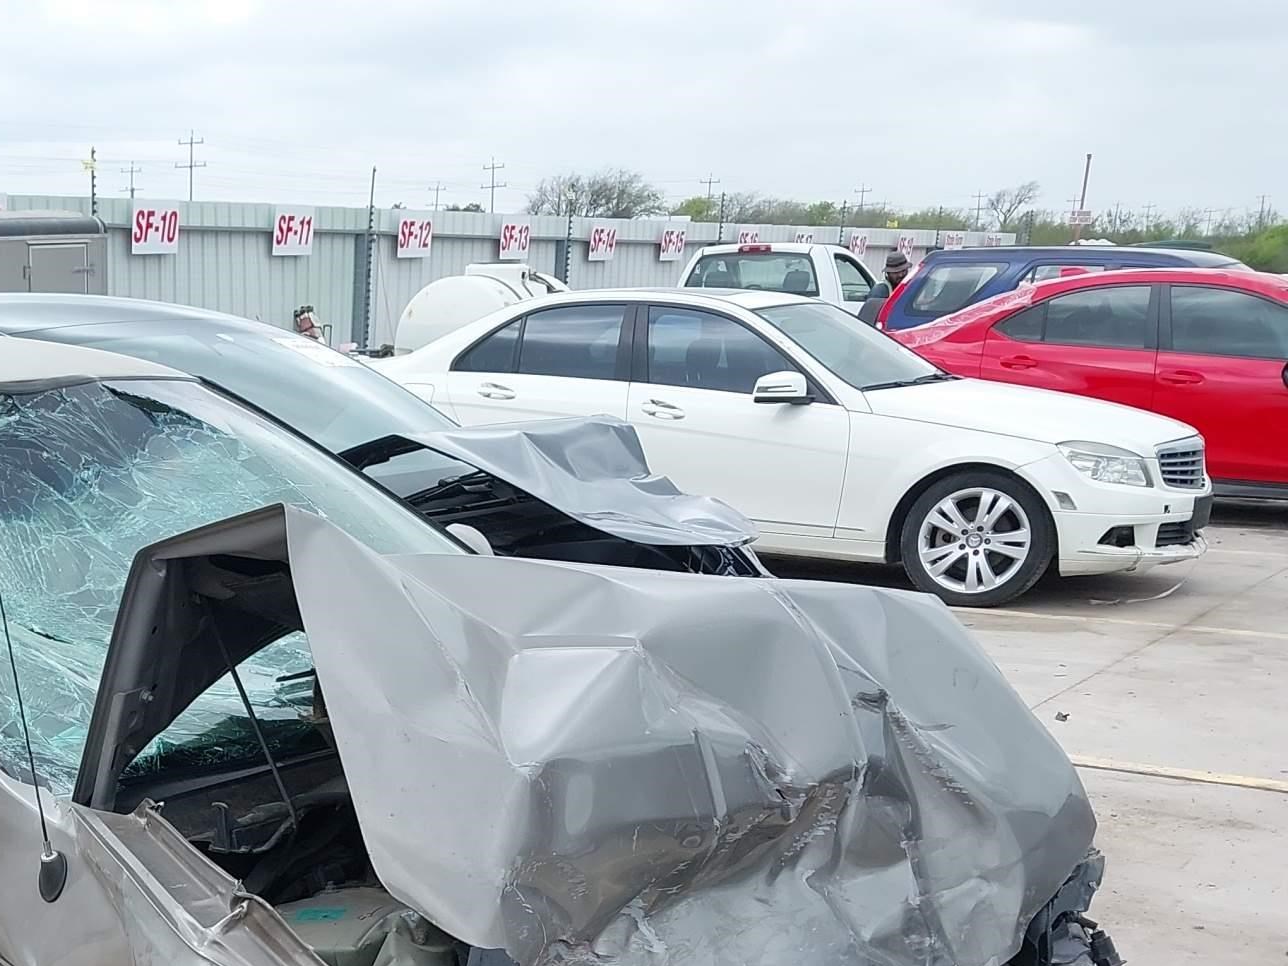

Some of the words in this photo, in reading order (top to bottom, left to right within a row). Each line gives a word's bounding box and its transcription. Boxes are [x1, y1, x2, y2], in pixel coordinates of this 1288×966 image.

[133, 210, 178, 244] SF-10
[275, 215, 313, 246] SF-11
[399, 220, 431, 248] SF-12
[501, 224, 530, 251] SF-13
[590, 228, 616, 253] SF-14
[661, 230, 686, 254] SF-15
